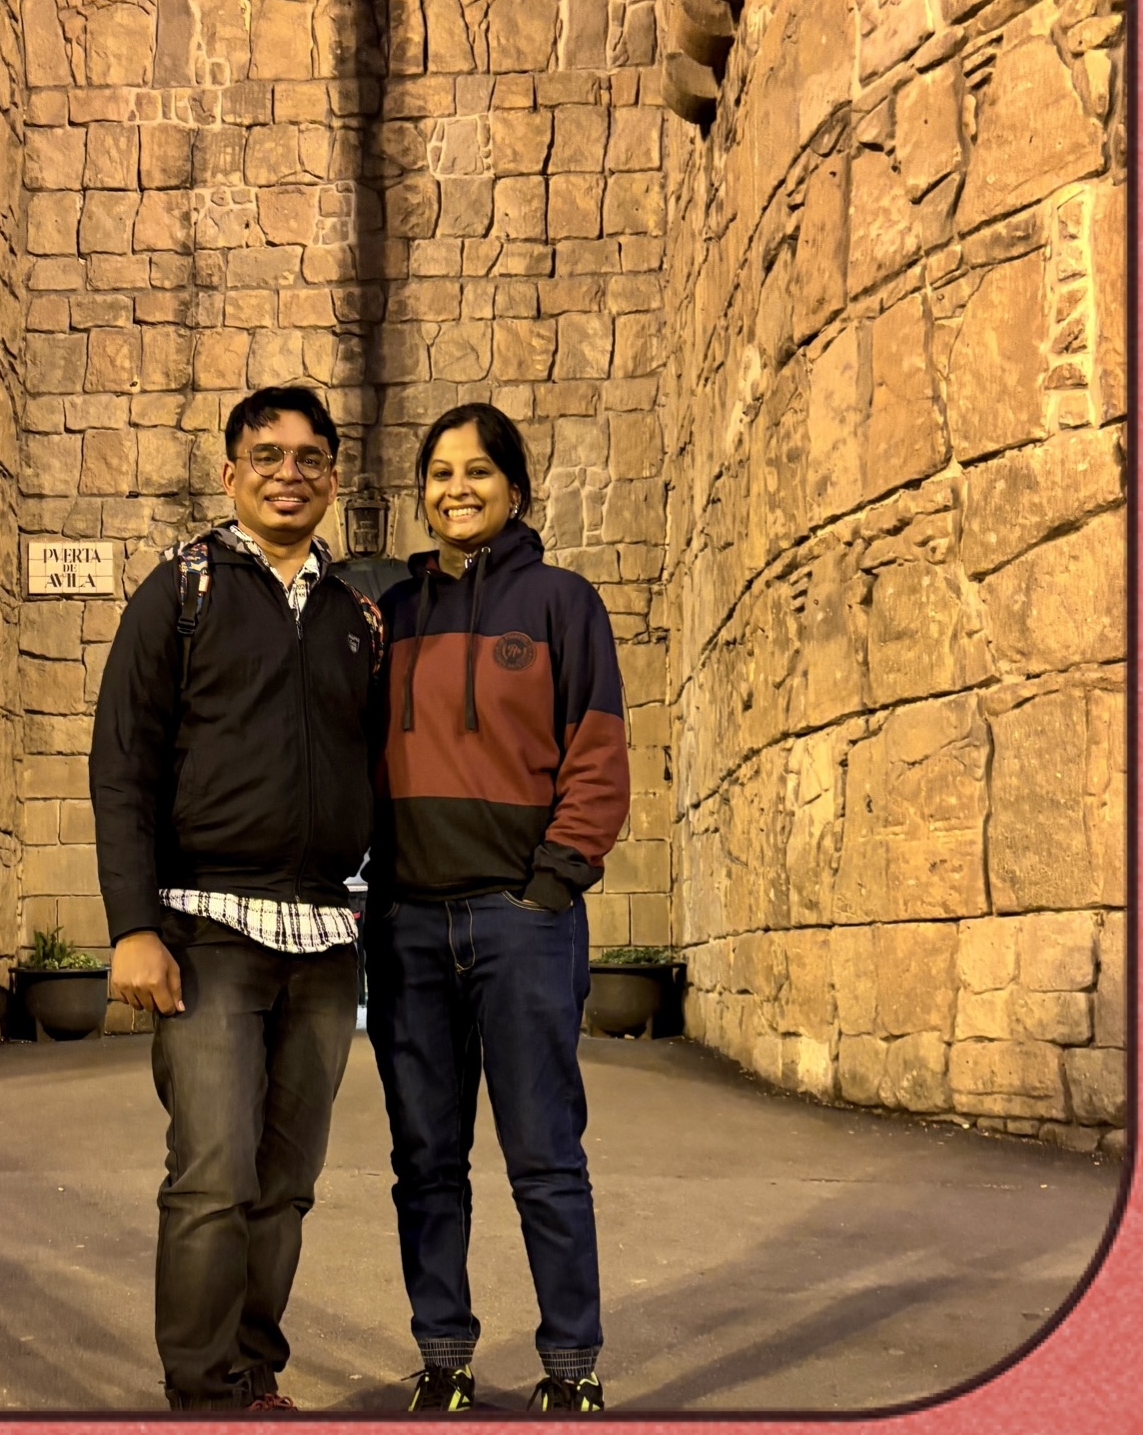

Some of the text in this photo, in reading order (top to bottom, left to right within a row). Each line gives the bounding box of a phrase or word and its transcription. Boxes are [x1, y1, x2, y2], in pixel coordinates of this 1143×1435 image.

[43, 548, 102, 564] PVERTA
[63, 564, 78, 573] DE
[45, 573, 96, 588] AVILA
